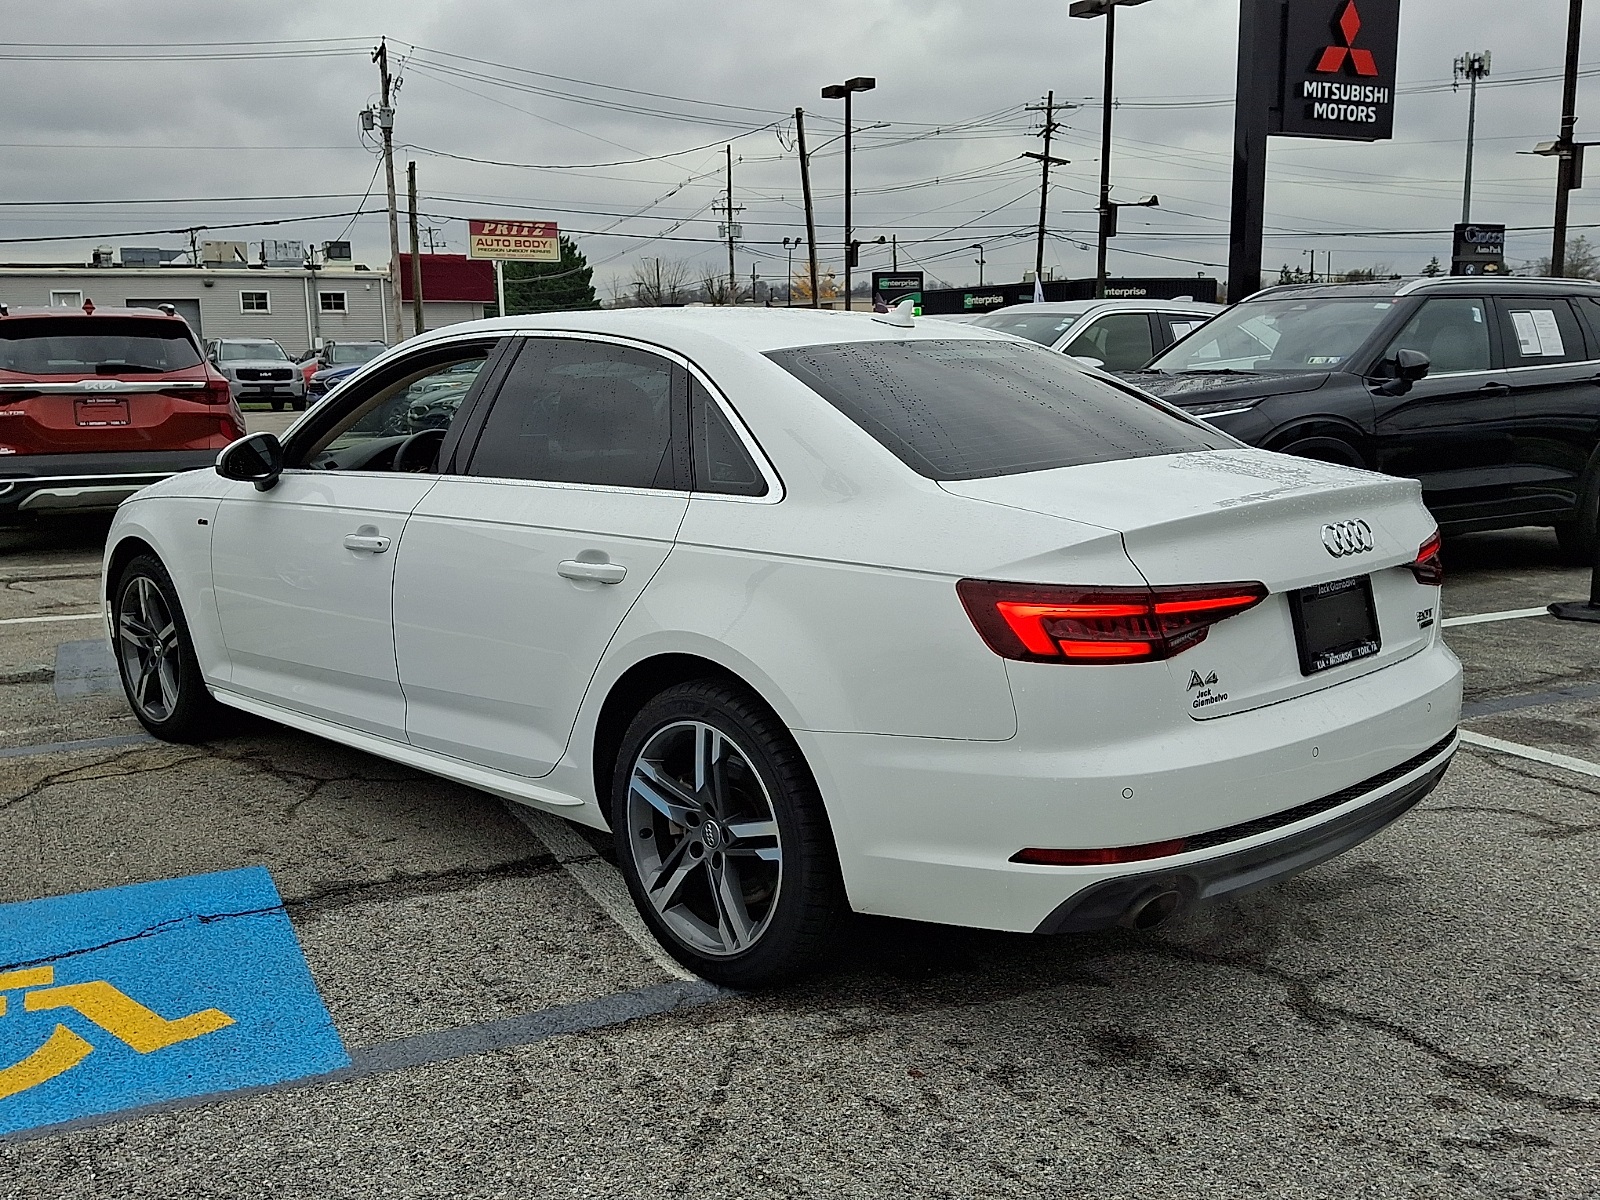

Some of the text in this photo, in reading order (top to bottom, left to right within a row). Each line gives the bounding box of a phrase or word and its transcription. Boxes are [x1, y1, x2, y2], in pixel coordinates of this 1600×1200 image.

[1303, 80, 1389, 104] MITSUBISHI
[1313, 101, 1377, 123] MOTORS
[482, 222, 546, 236] PRITZ
[476, 238, 513, 247] AUTO
[514, 239, 549, 249] BODY
[879, 279, 919, 288] enterprise
[965, 294, 1004, 308] enterprise
[1318, 583, 1330, 595] Jack
[1186, 669, 1219, 691] A4
[1196, 687, 1212, 699] Jack
[1192, 692, 1229, 709] Giambalvo
